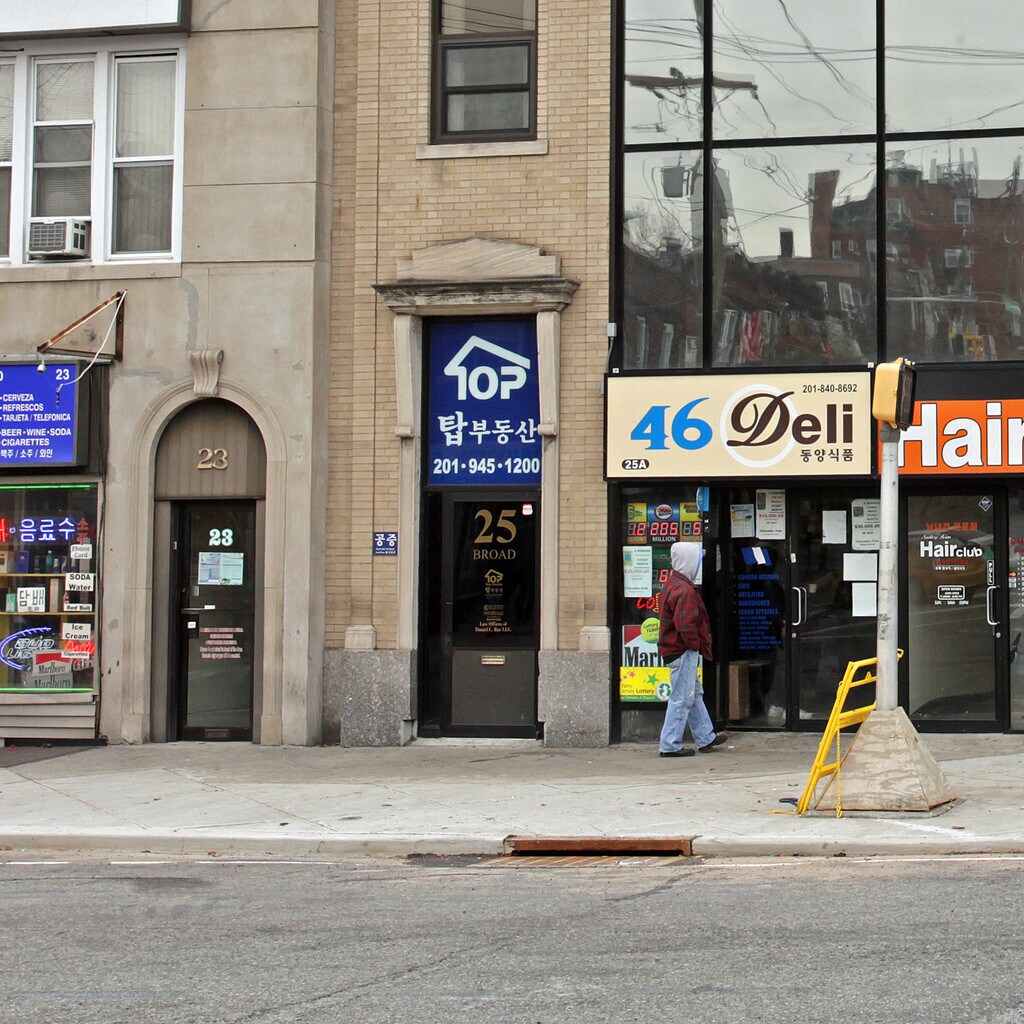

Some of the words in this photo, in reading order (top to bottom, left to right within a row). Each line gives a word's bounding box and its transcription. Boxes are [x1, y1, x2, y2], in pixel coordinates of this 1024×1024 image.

[56, 369, 69, 380] 23
[802, 383, 858, 393] 201-840-8692
[630, 397, 713, 450] 46
[726, 391, 853, 447] Deli
[197, 448, 229, 470] 23
[800, 448, 854, 462] 동양식품
[625, 460, 647, 470] 25A
[19, 517, 76, 543] 음료수
[474, 509, 517, 544] 25
[208, 528, 234, 547] 23
[473, 550, 517, 560] BROAD
[20, 590, 45, 607] 담배
[38, 662, 66, 674] Marlboro
